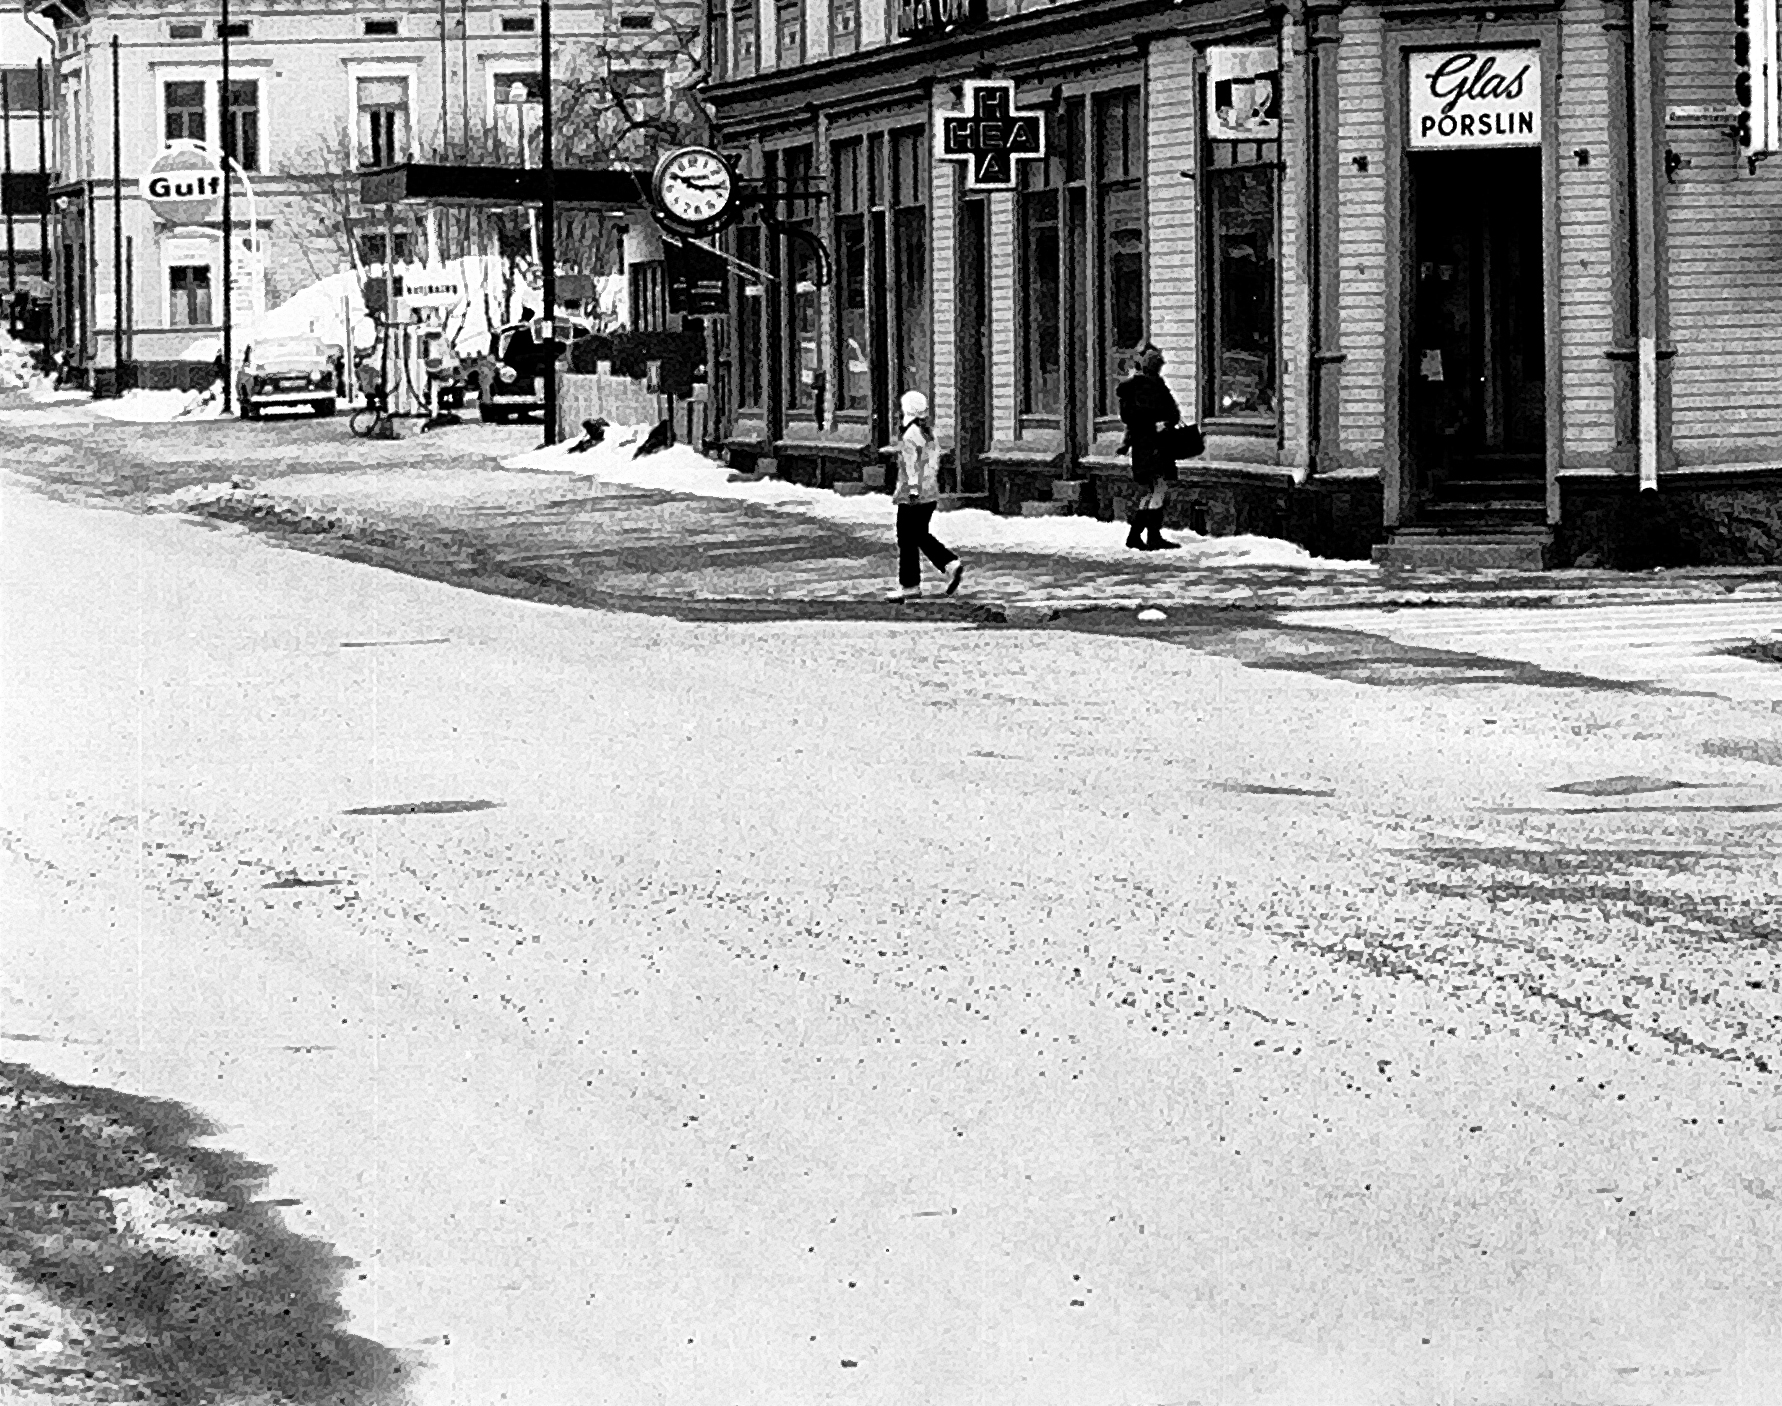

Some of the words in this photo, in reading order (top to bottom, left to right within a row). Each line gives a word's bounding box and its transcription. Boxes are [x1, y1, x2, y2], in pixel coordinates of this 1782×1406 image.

[1425, 53, 1531, 114] Glas
[949, 122, 1035, 148] HEA
[1421, 112, 1533, 137] PORSLIN
[148, 177, 220, 198] Gulf
